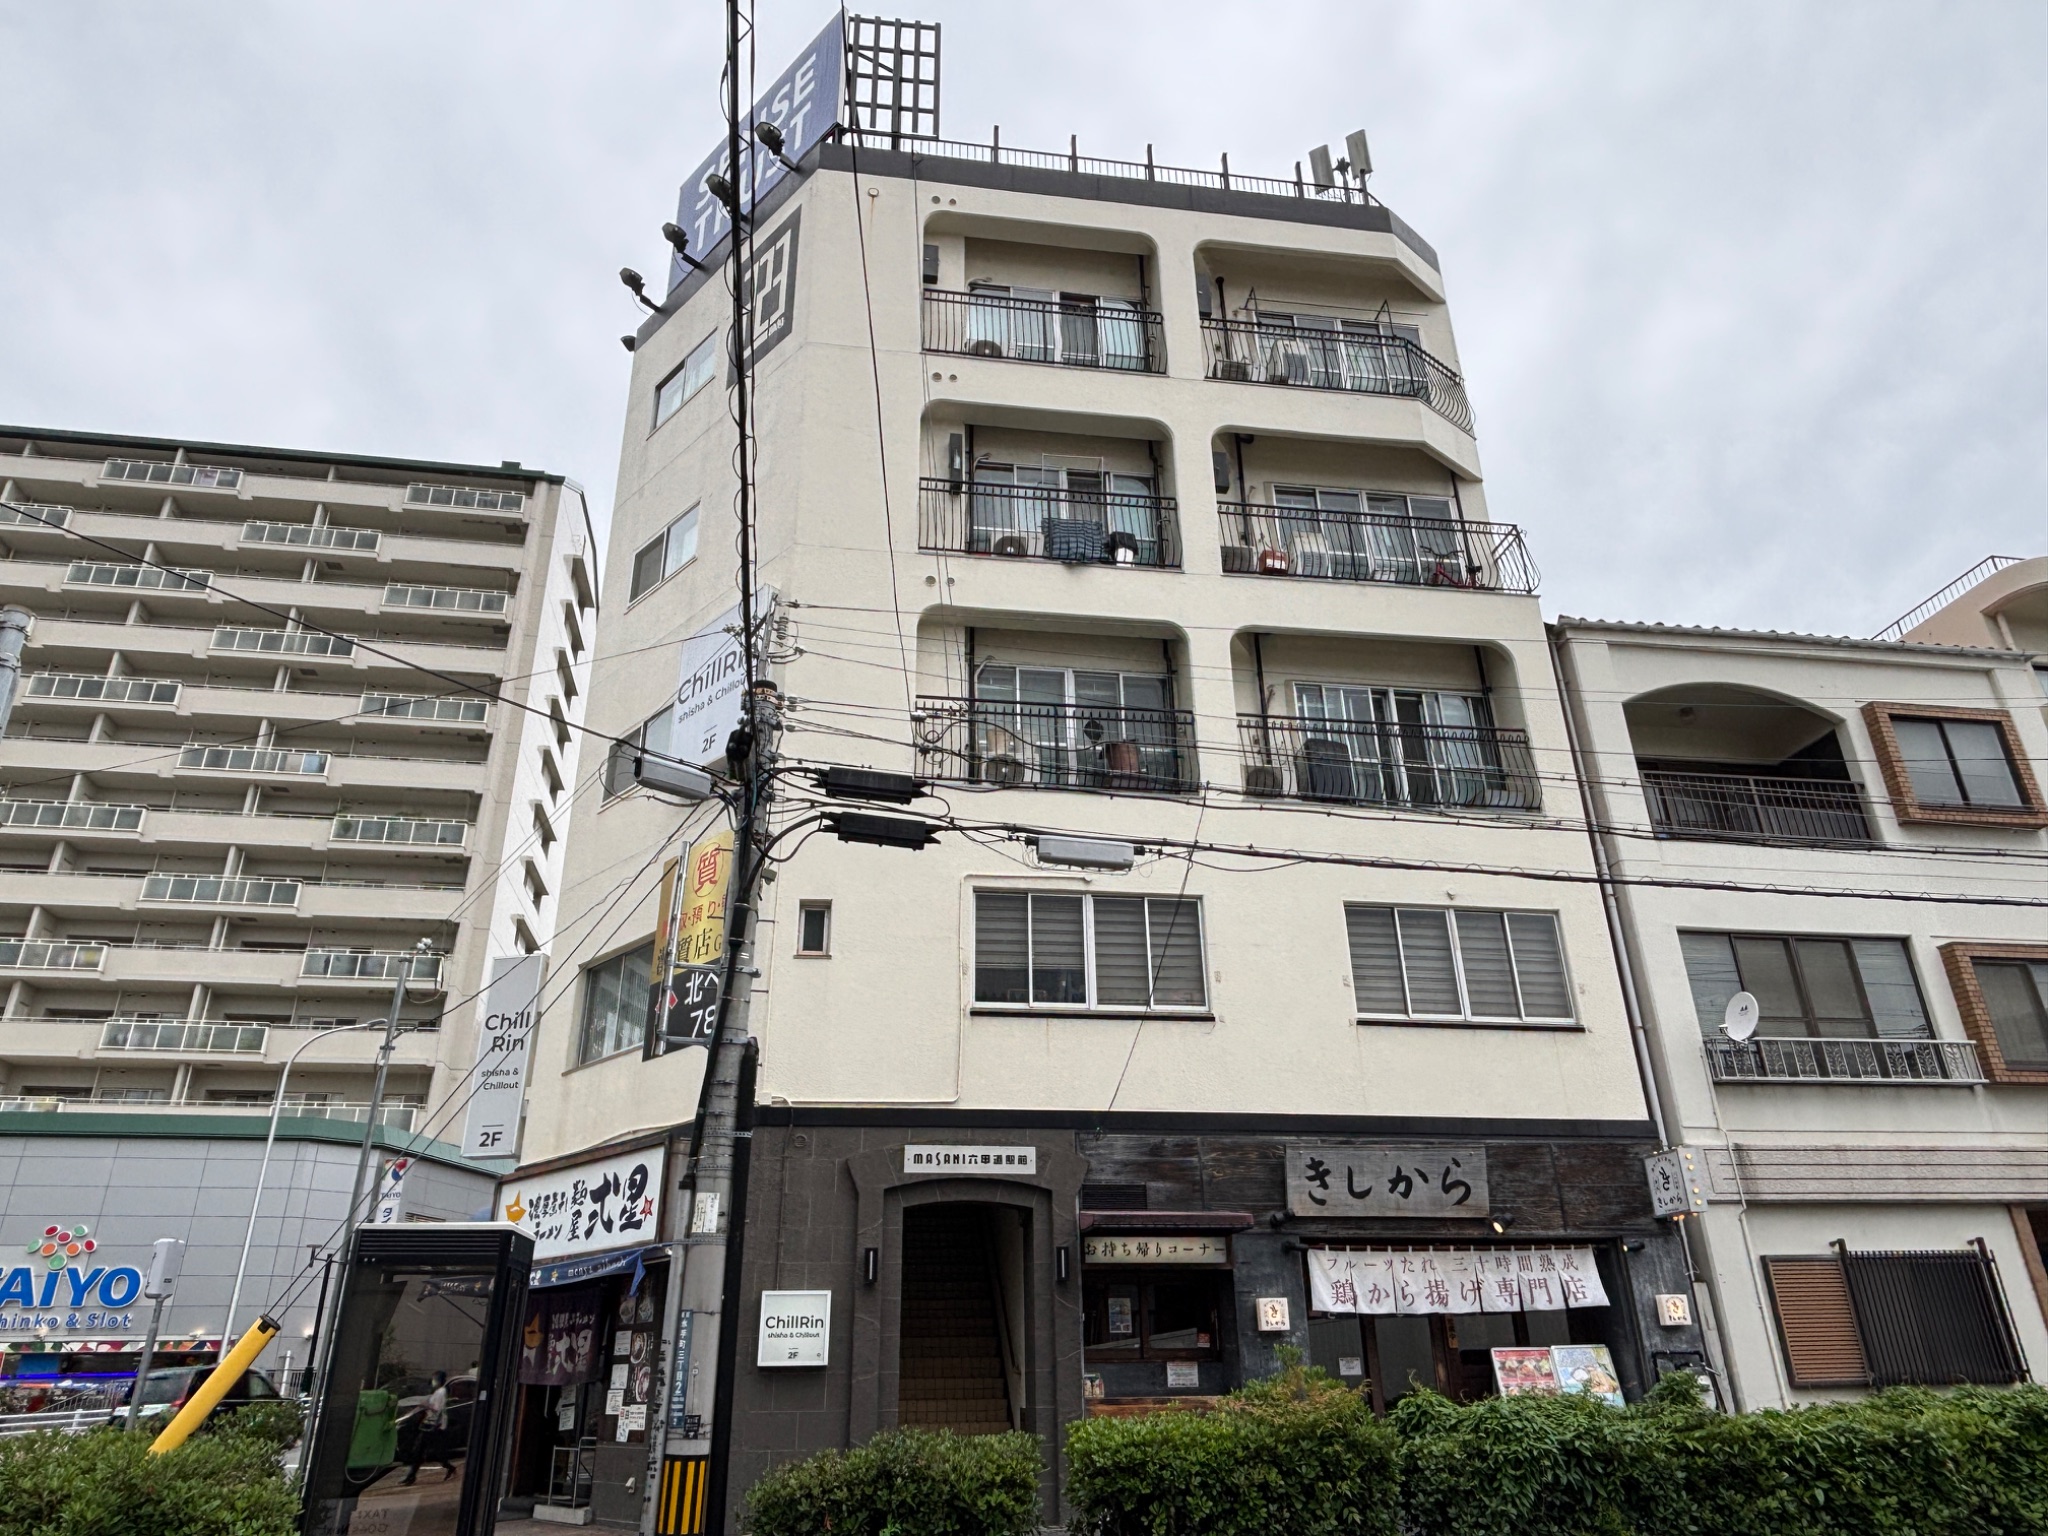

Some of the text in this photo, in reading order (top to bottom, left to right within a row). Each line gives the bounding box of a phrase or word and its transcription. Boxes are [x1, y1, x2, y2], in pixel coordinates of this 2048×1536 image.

[707, 695, 713, 706] &
[701, 733, 717, 754] 2F
[694, 844, 721, 895] 質
[484, 1011, 531, 1031] Chill
[491, 1034, 525, 1052] Rin
[481, 1065, 519, 1078] shisha &
[483, 1080, 519, 1091] Chillout
[478, 1130, 503, 1148] 2F
[1304, 1156, 1472, 1206] きしから
[1085, 1240, 1226, 1258] お持ち帰りコーナー
[0, 1267, 142, 1308] AIYO
[1331, 1276, 1587, 1307] 鶏から揚げ専門店
[66, 1312, 79, 1329] &
[86, 1311, 131, 1329] Slot
[765, 1314, 824, 1329] ChillRin
[787, 1351, 799, 1360] 2F
